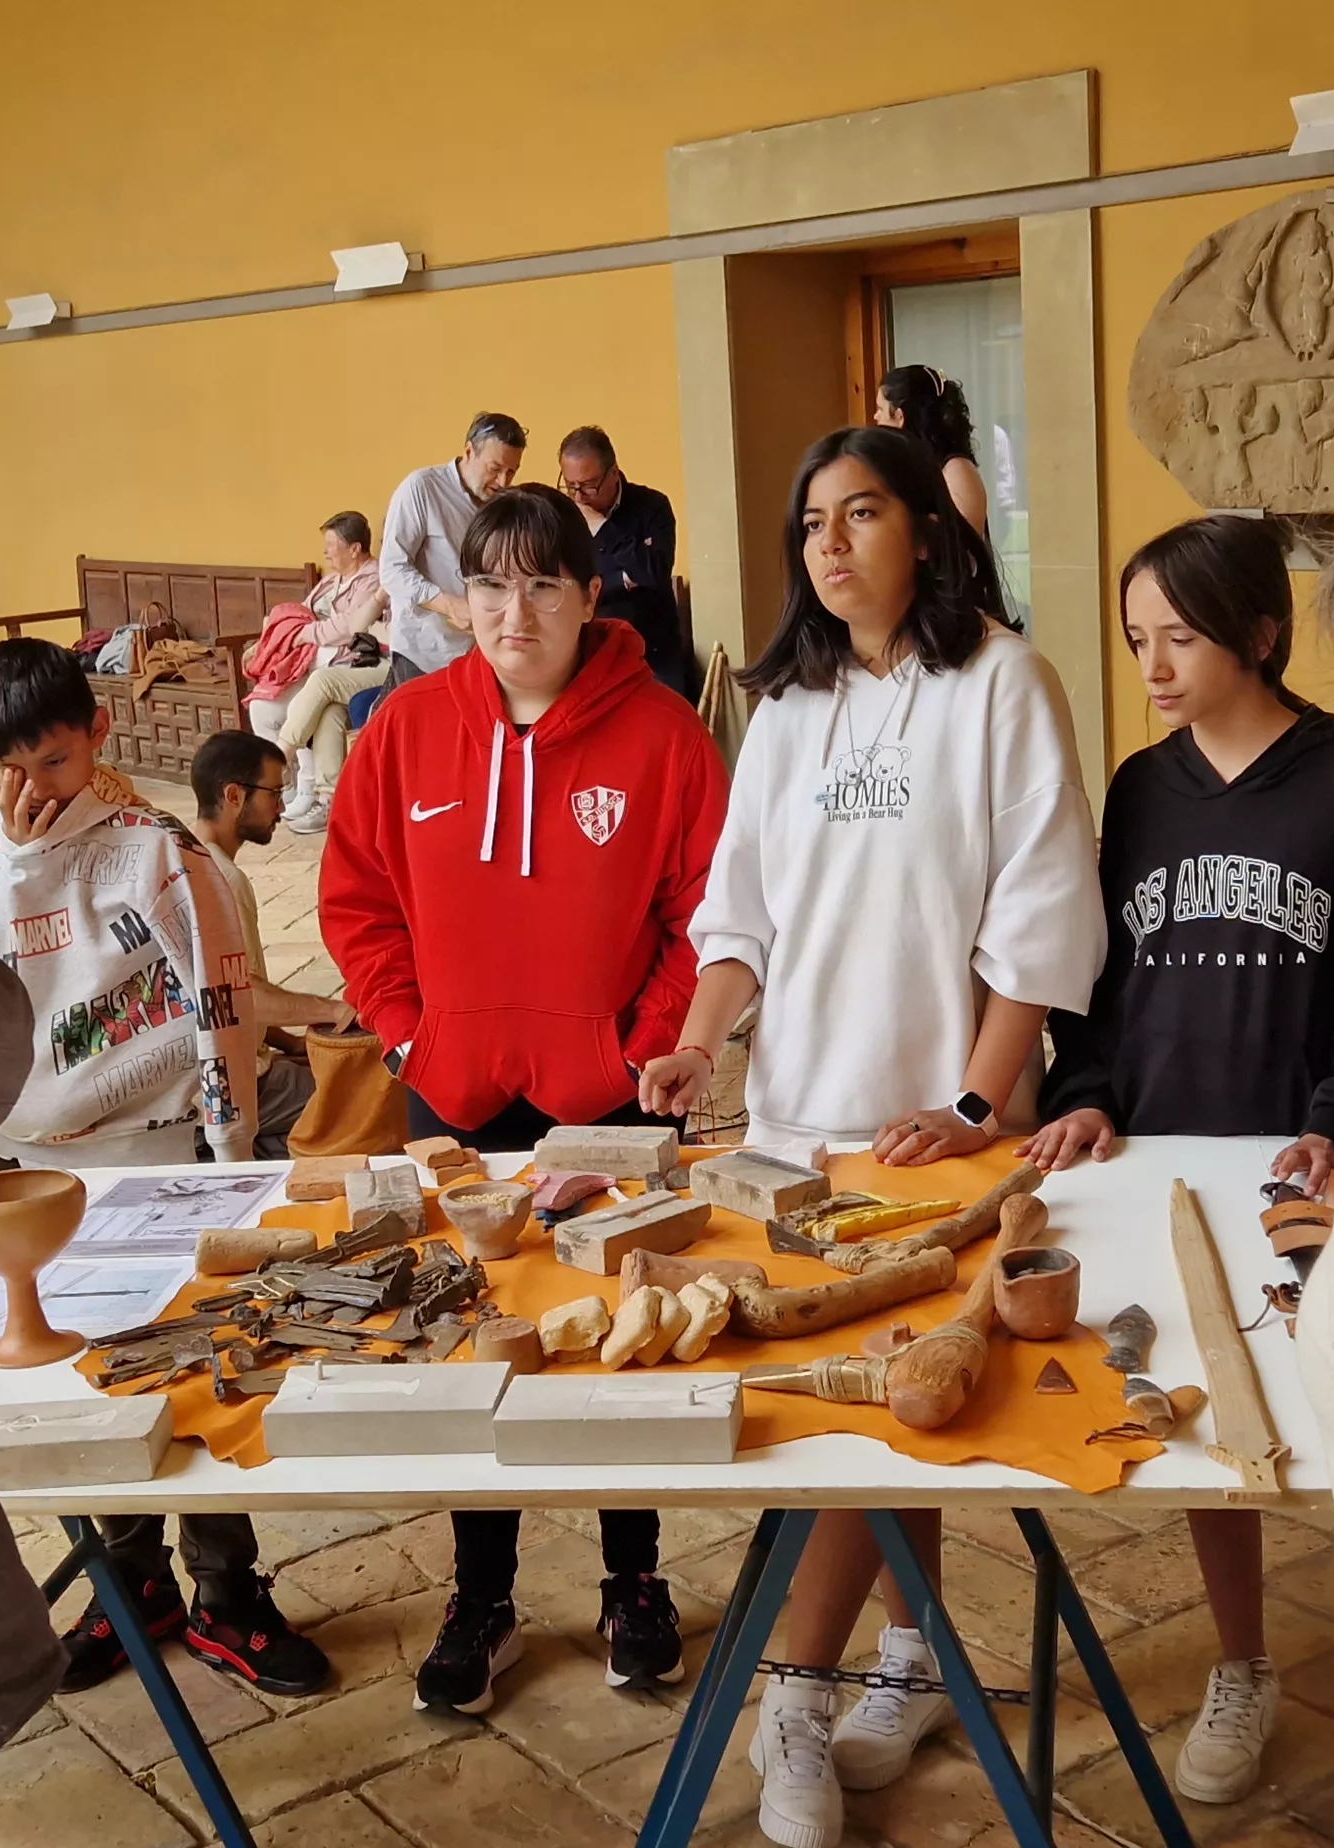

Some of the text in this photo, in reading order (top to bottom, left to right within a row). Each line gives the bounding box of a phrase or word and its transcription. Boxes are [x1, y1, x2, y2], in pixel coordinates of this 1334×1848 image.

[823, 776, 910, 811] HOMIES
[827, 811, 851, 824] Living
[853, 810, 860, 820] in
[868, 807, 886, 819] Bear
[888, 806, 903, 820] Hug
[1173, 854, 1331, 953] ANGELES
[10, 908, 72, 957] MARVEL
[1133, 951, 1306, 967] ALIFORNIA
[93, 1034, 195, 1114] MARVEL
